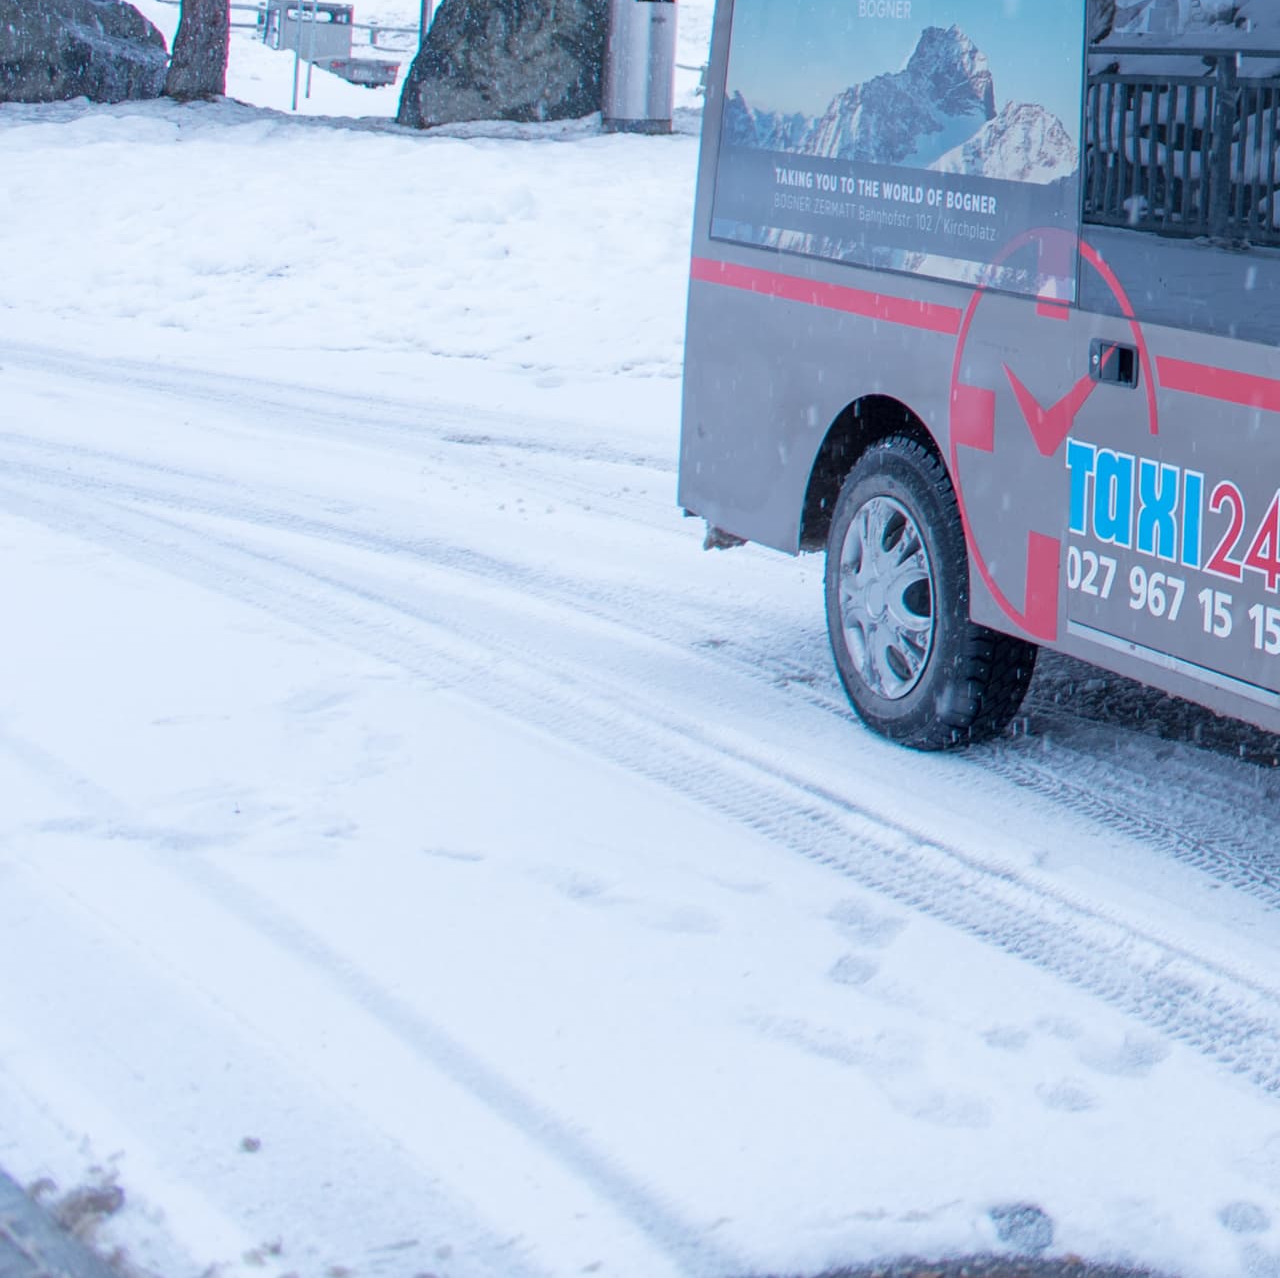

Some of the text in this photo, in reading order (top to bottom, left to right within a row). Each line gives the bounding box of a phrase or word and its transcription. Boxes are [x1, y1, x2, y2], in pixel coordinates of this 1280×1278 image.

[775, 168, 997, 215] TAKING YOU TO THE WORLD OF BOGNER
[774, 192, 811, 213] BOGNER
[813, 197, 857, 219] ZERMATT
[916, 212, 932, 232] 102
[943, 218, 997, 242] Kirchplatz
[1066, 545, 1118, 600] 027
[1128, 565, 1186, 621] 967
[1198, 587, 1233, 639] 15
